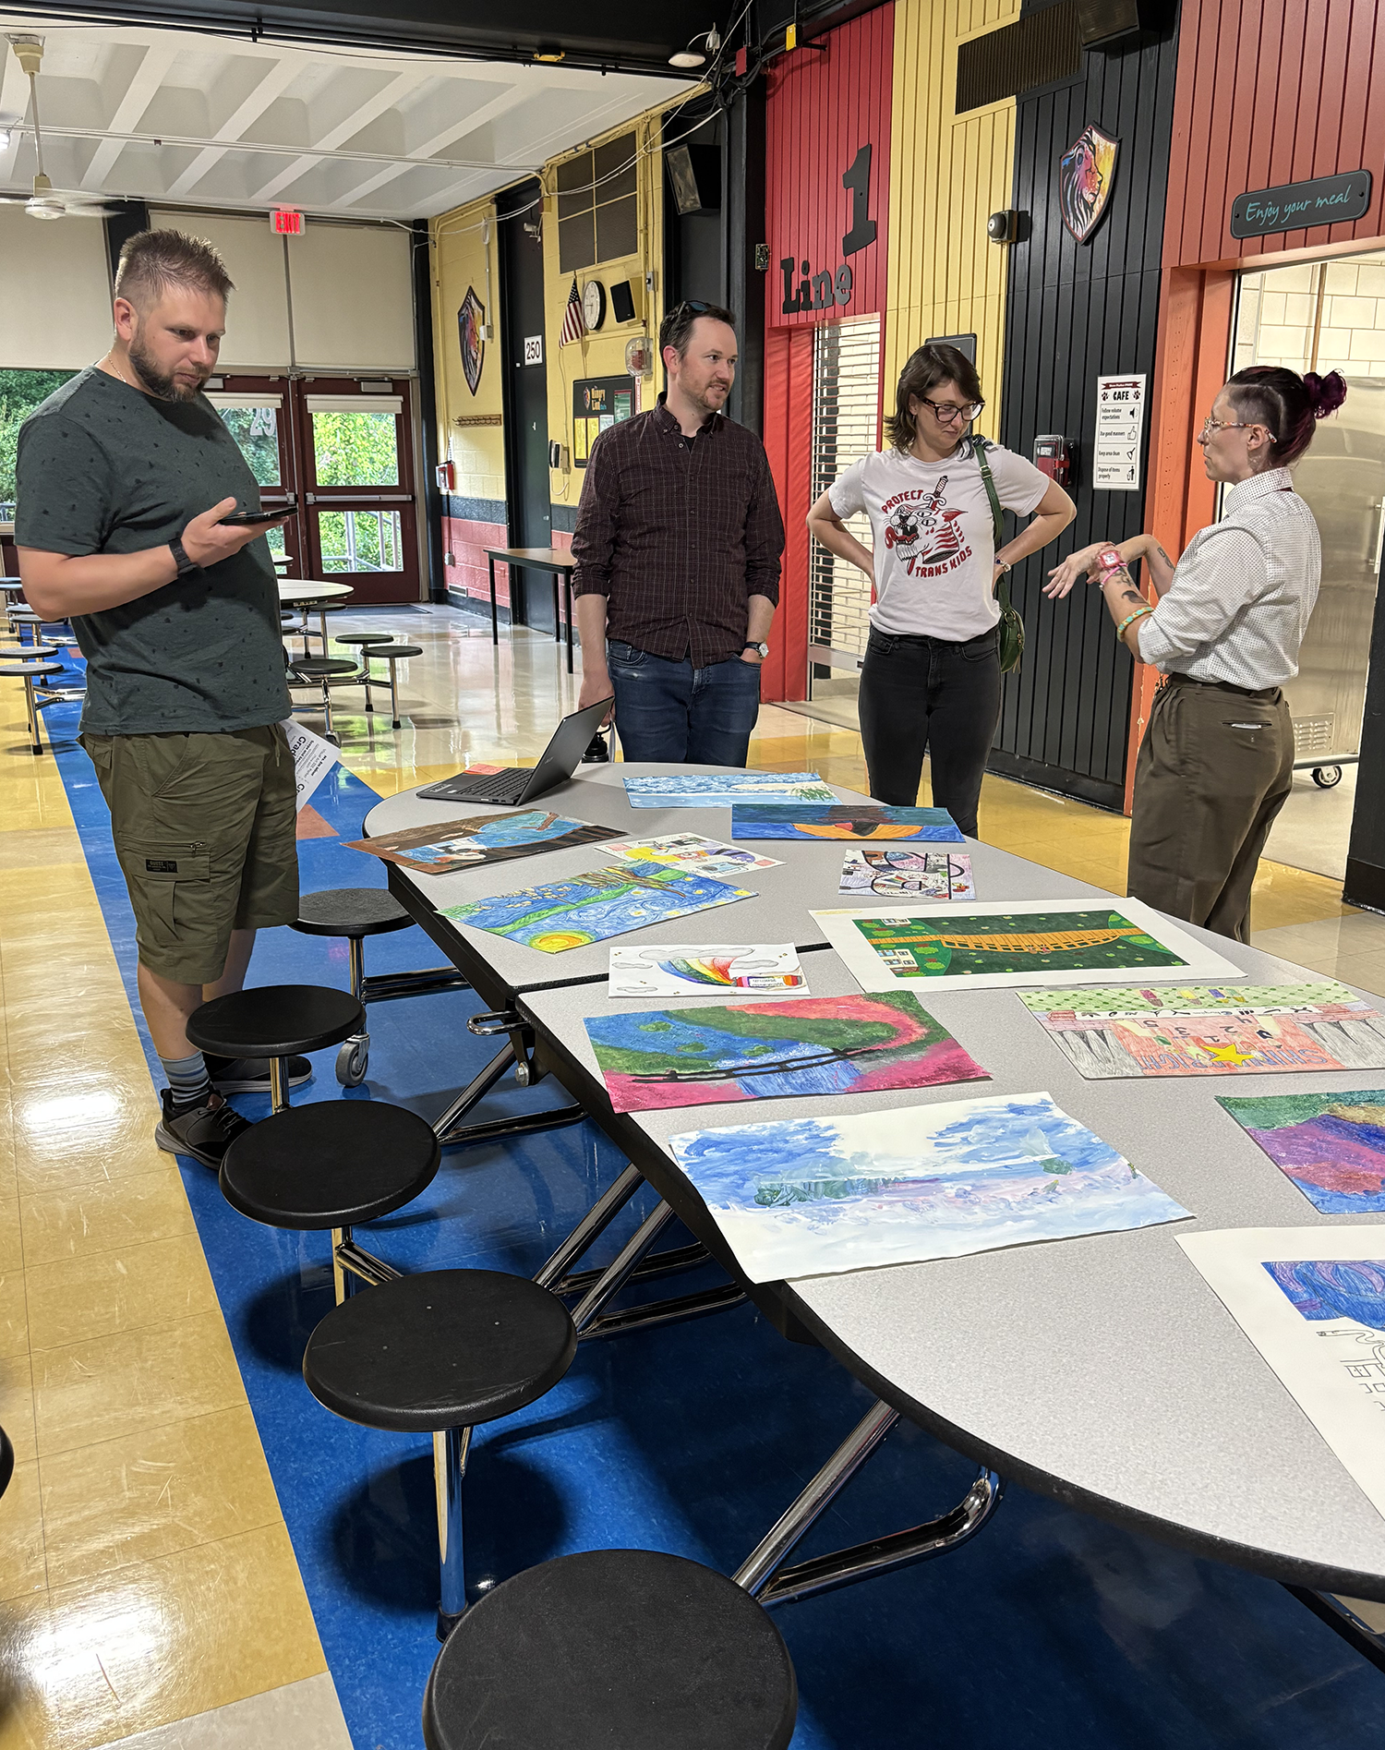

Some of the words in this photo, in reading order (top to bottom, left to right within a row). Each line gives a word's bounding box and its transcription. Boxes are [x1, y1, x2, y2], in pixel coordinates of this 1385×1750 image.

[1245, 201, 1280, 226] Enjoy
[1280, 199, 1311, 223] your
[1315, 184, 1351, 208] meal
[275, 211, 301, 234] EXIT
[780, 257, 852, 314] Line
[842, 143, 876, 257] 1
[526, 341, 541, 360] 250
[1113, 391, 1129, 401] CAFE
[881, 489, 924, 514] PROTECT
[915, 563, 948, 578] TRANS
[949, 545, 972, 569] KIDS
[1143, 1019, 1159, 1028] 5
[1174, 1027, 1190, 1036] 3
[1219, 1026, 1238, 1034] 2
[1203, 1035, 1220, 1043] 1
